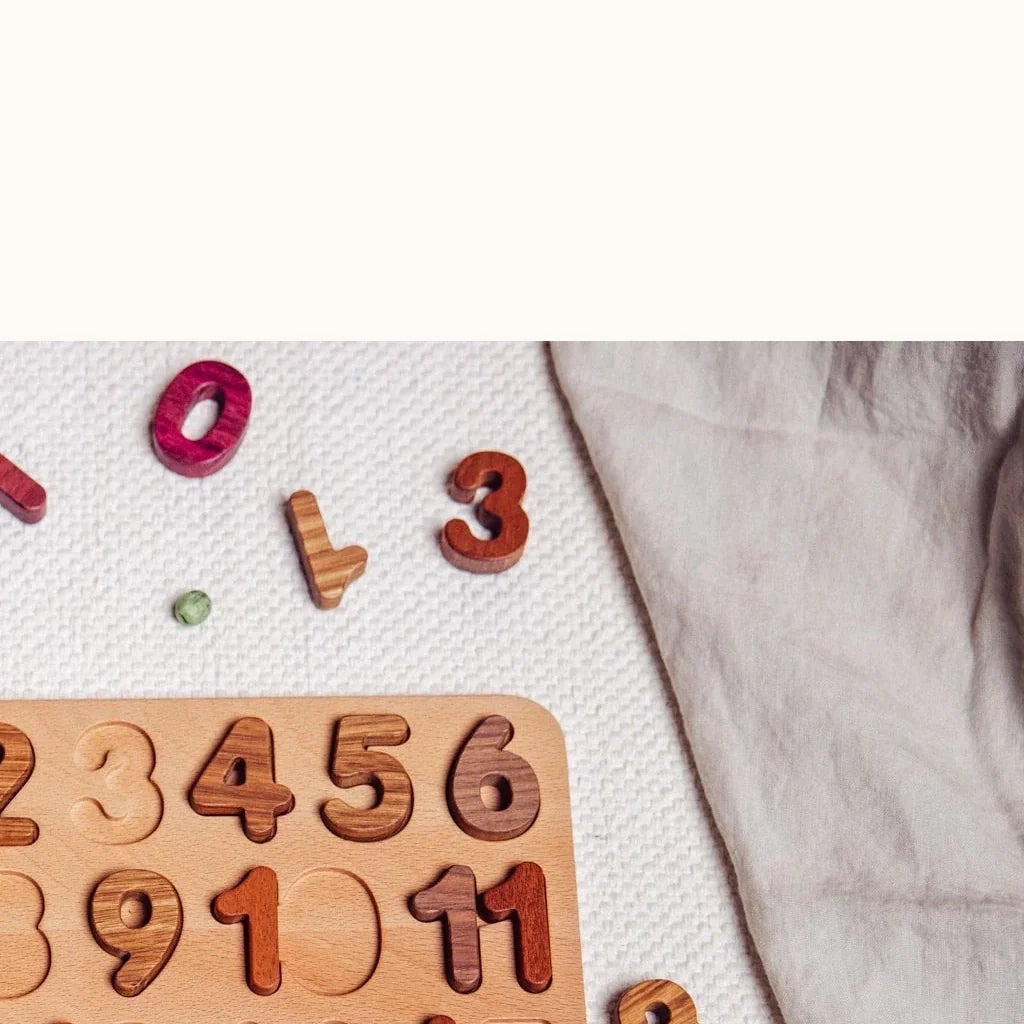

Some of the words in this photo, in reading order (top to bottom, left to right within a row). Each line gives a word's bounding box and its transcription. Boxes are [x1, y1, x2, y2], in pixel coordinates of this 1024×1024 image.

[149, 360, 253, 478] 0
[437, 451, 530, 573] 3
[70, 720, 164, 845] 3
[188, 716, 295, 844] 4
[320, 714, 414, 843] 5
[446, 714, 541, 841] 6
[86, 868, 184, 998] 9
[408, 861, 553, 994] 11
